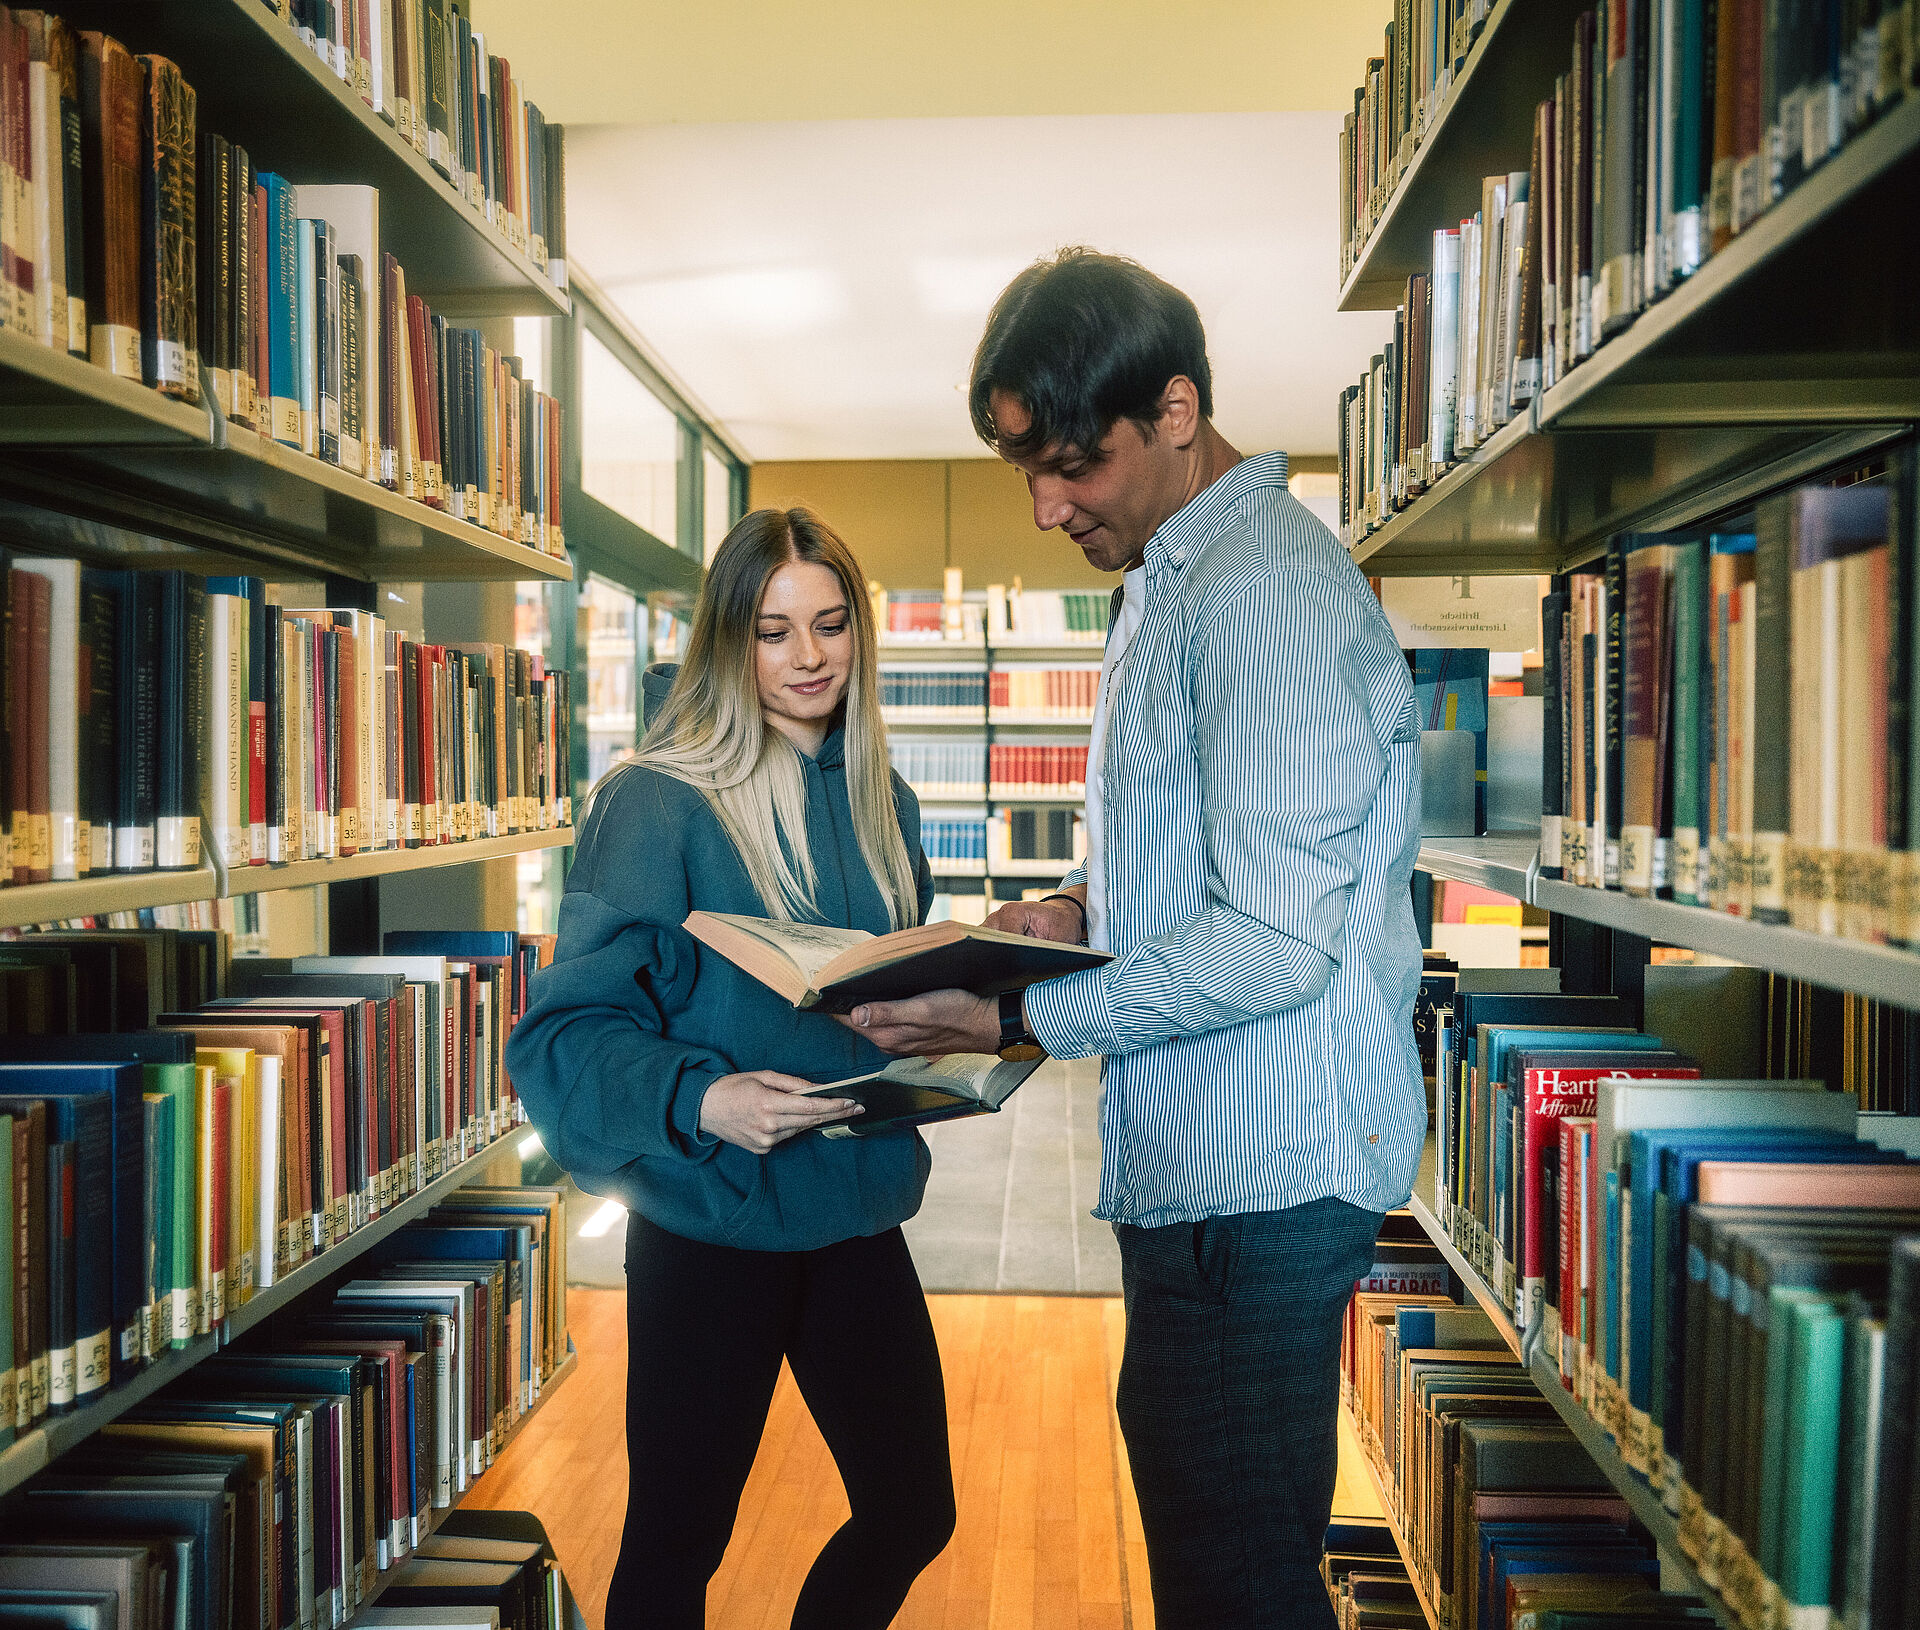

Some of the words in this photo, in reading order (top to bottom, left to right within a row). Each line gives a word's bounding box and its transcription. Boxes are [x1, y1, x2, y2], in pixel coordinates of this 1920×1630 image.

[279, 186, 288, 230] Charles
[289, 194, 297, 222] THE
[241, 226, 248, 243] OF
[279, 232, 288, 242] L.
[289, 225, 297, 280] GOTHIC
[280, 245, 288, 294] Eastlake
[240, 272, 248, 316] EARTH
[289, 284, 297, 345] REVIVAL
[349, 321, 356, 333] M.
[343, 373, 349, 386] IN
[187, 614, 198, 663] English
[188, 668, 197, 735] Literature
[137, 725, 145, 798] LITERATURE
[1454, 1017, 1462, 1066] Hungry
[1535, 1097, 1580, 1122] Jeffrey
[1560, 1131, 1569, 1162] THIS
[1560, 1164, 1569, 1221] FRAGILE
[1560, 1224, 1569, 1270] EARTH
[1389, 1271, 1410, 1279] MAJOR
[1419, 1271, 1442, 1280] SERIES
[441, 1476, 449, 1486] 4
